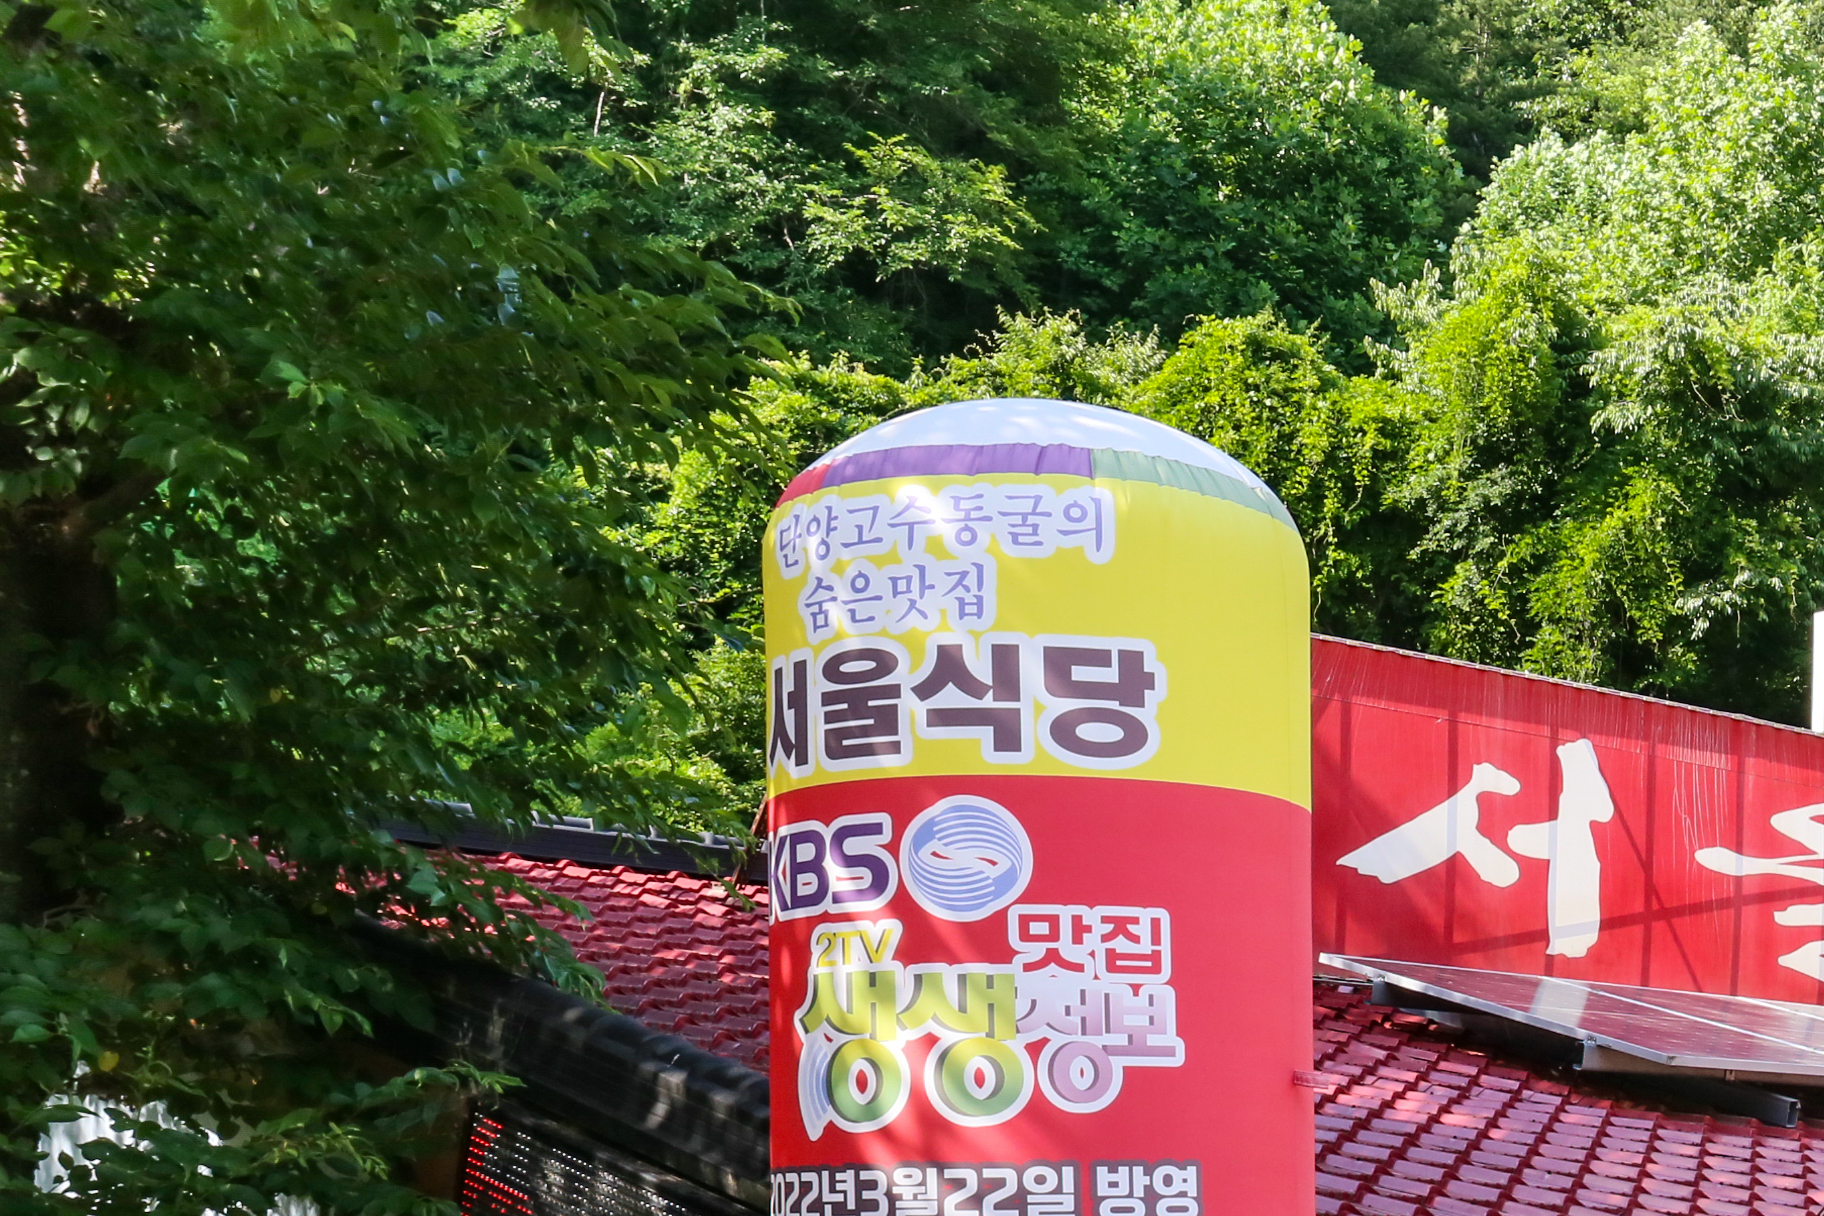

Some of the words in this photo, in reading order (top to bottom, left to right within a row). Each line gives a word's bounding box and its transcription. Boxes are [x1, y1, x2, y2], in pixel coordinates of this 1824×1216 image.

[778, 491, 1104, 569] 단양고수동굴의
[803, 562, 986, 634] 숨은맛집
[769, 642, 1156, 769] 서울식당
[769, 821, 890, 917] KBS
[815, 927, 894, 968] 2TV
[1016, 911, 1162, 977] 맛집
[801, 969, 1178, 1124] 생생정보
